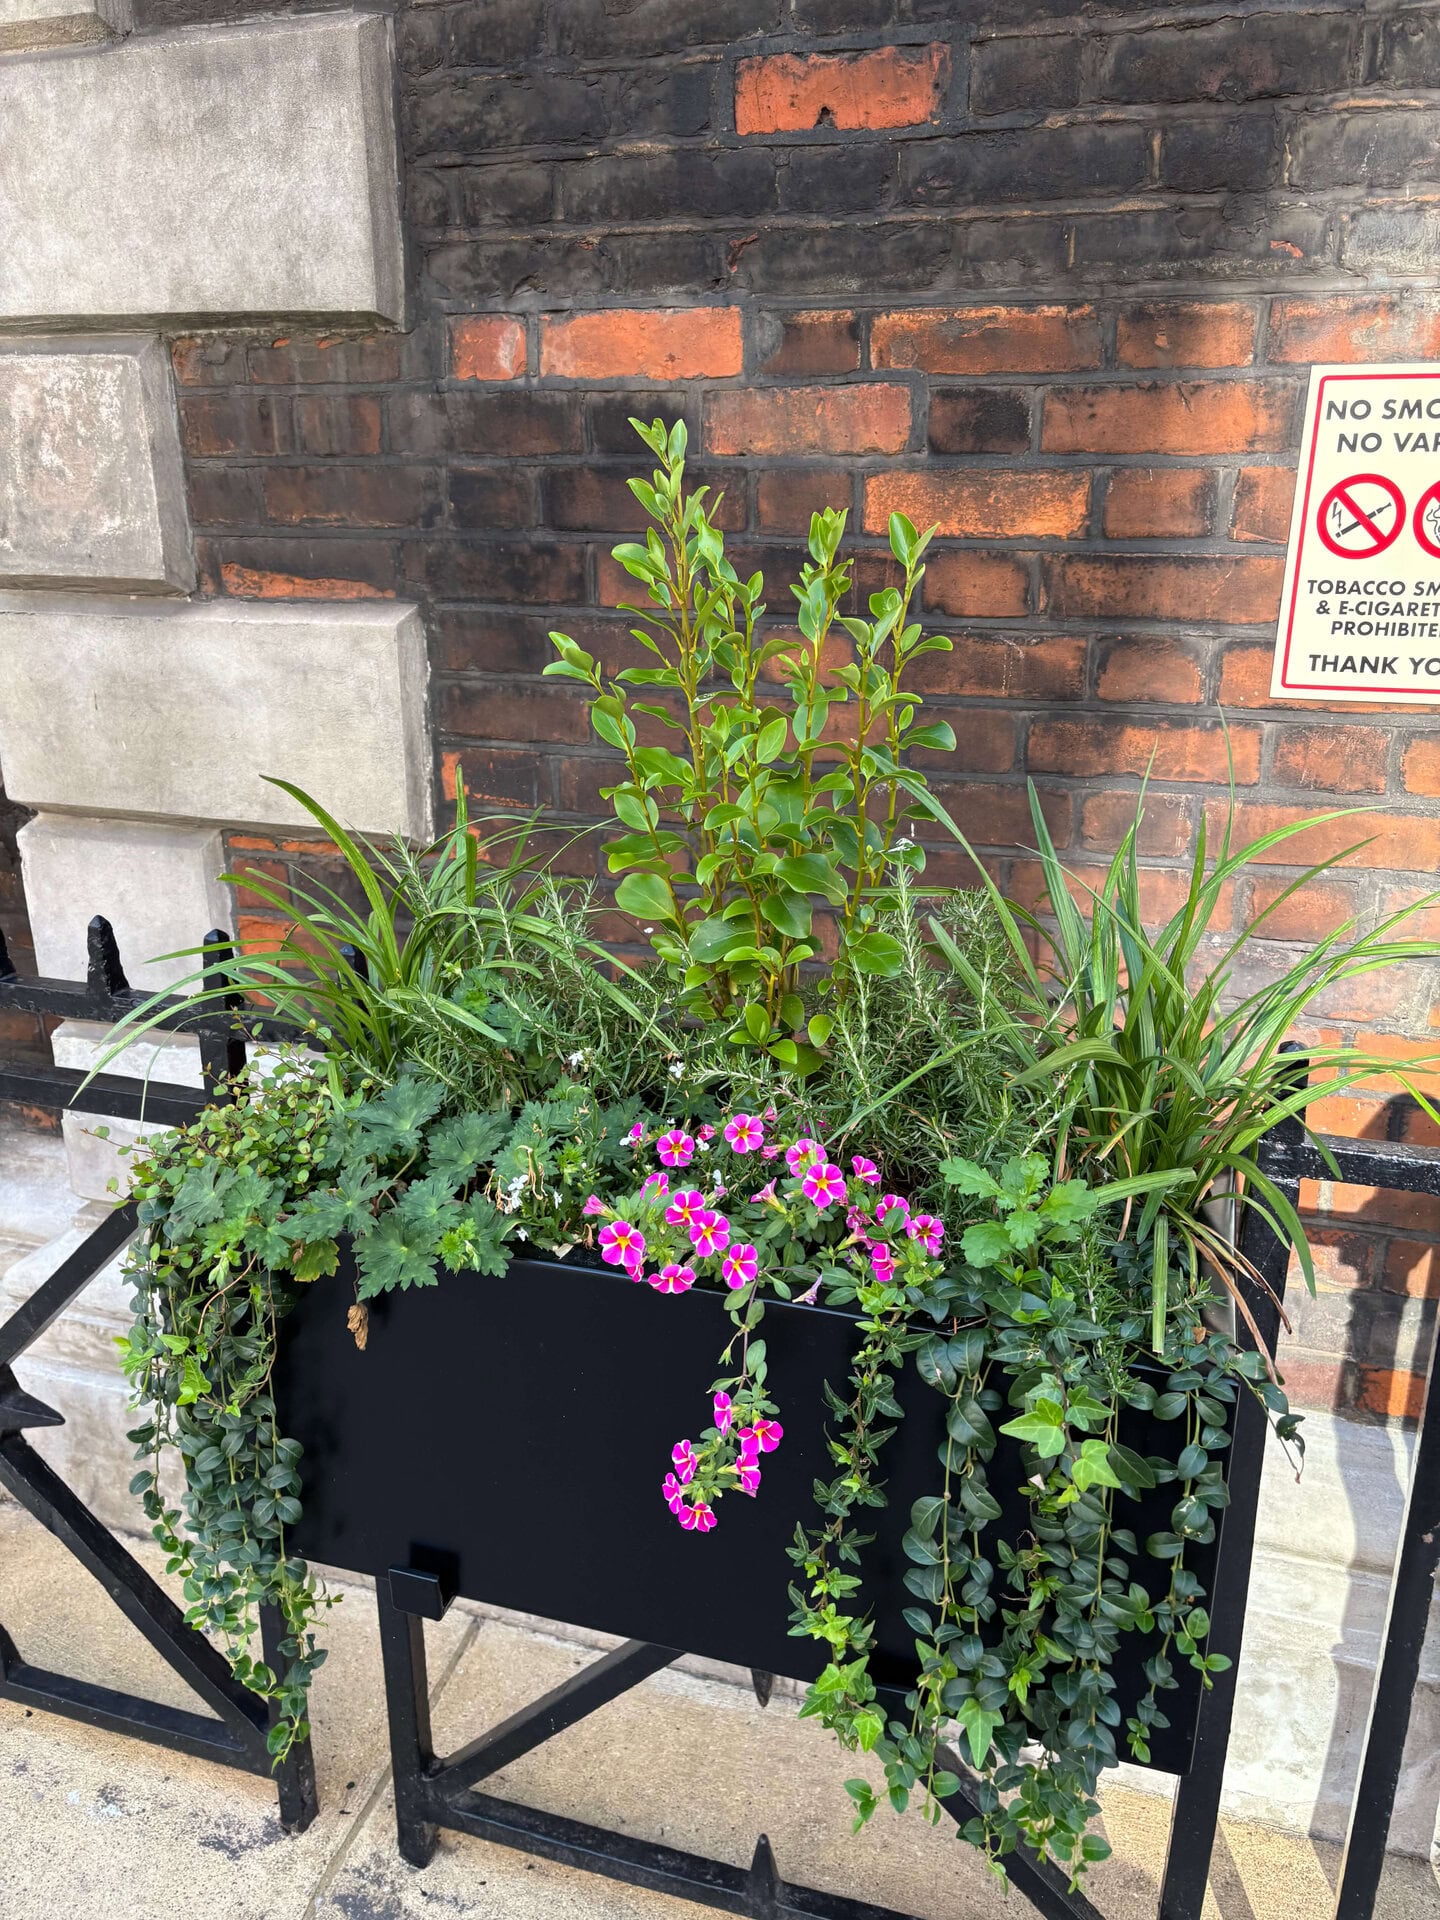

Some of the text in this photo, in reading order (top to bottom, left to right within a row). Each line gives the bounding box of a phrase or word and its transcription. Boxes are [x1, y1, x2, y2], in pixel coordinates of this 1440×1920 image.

[1326, 399, 1371, 420] NO
[1336, 433, 1382, 453] NO
[1307, 579, 1406, 596] TOBACCO
[1316, 600, 1330, 615] &
[1330, 621, 1440, 637] PROHIBITE
[1309, 654, 1399, 675] THANK
